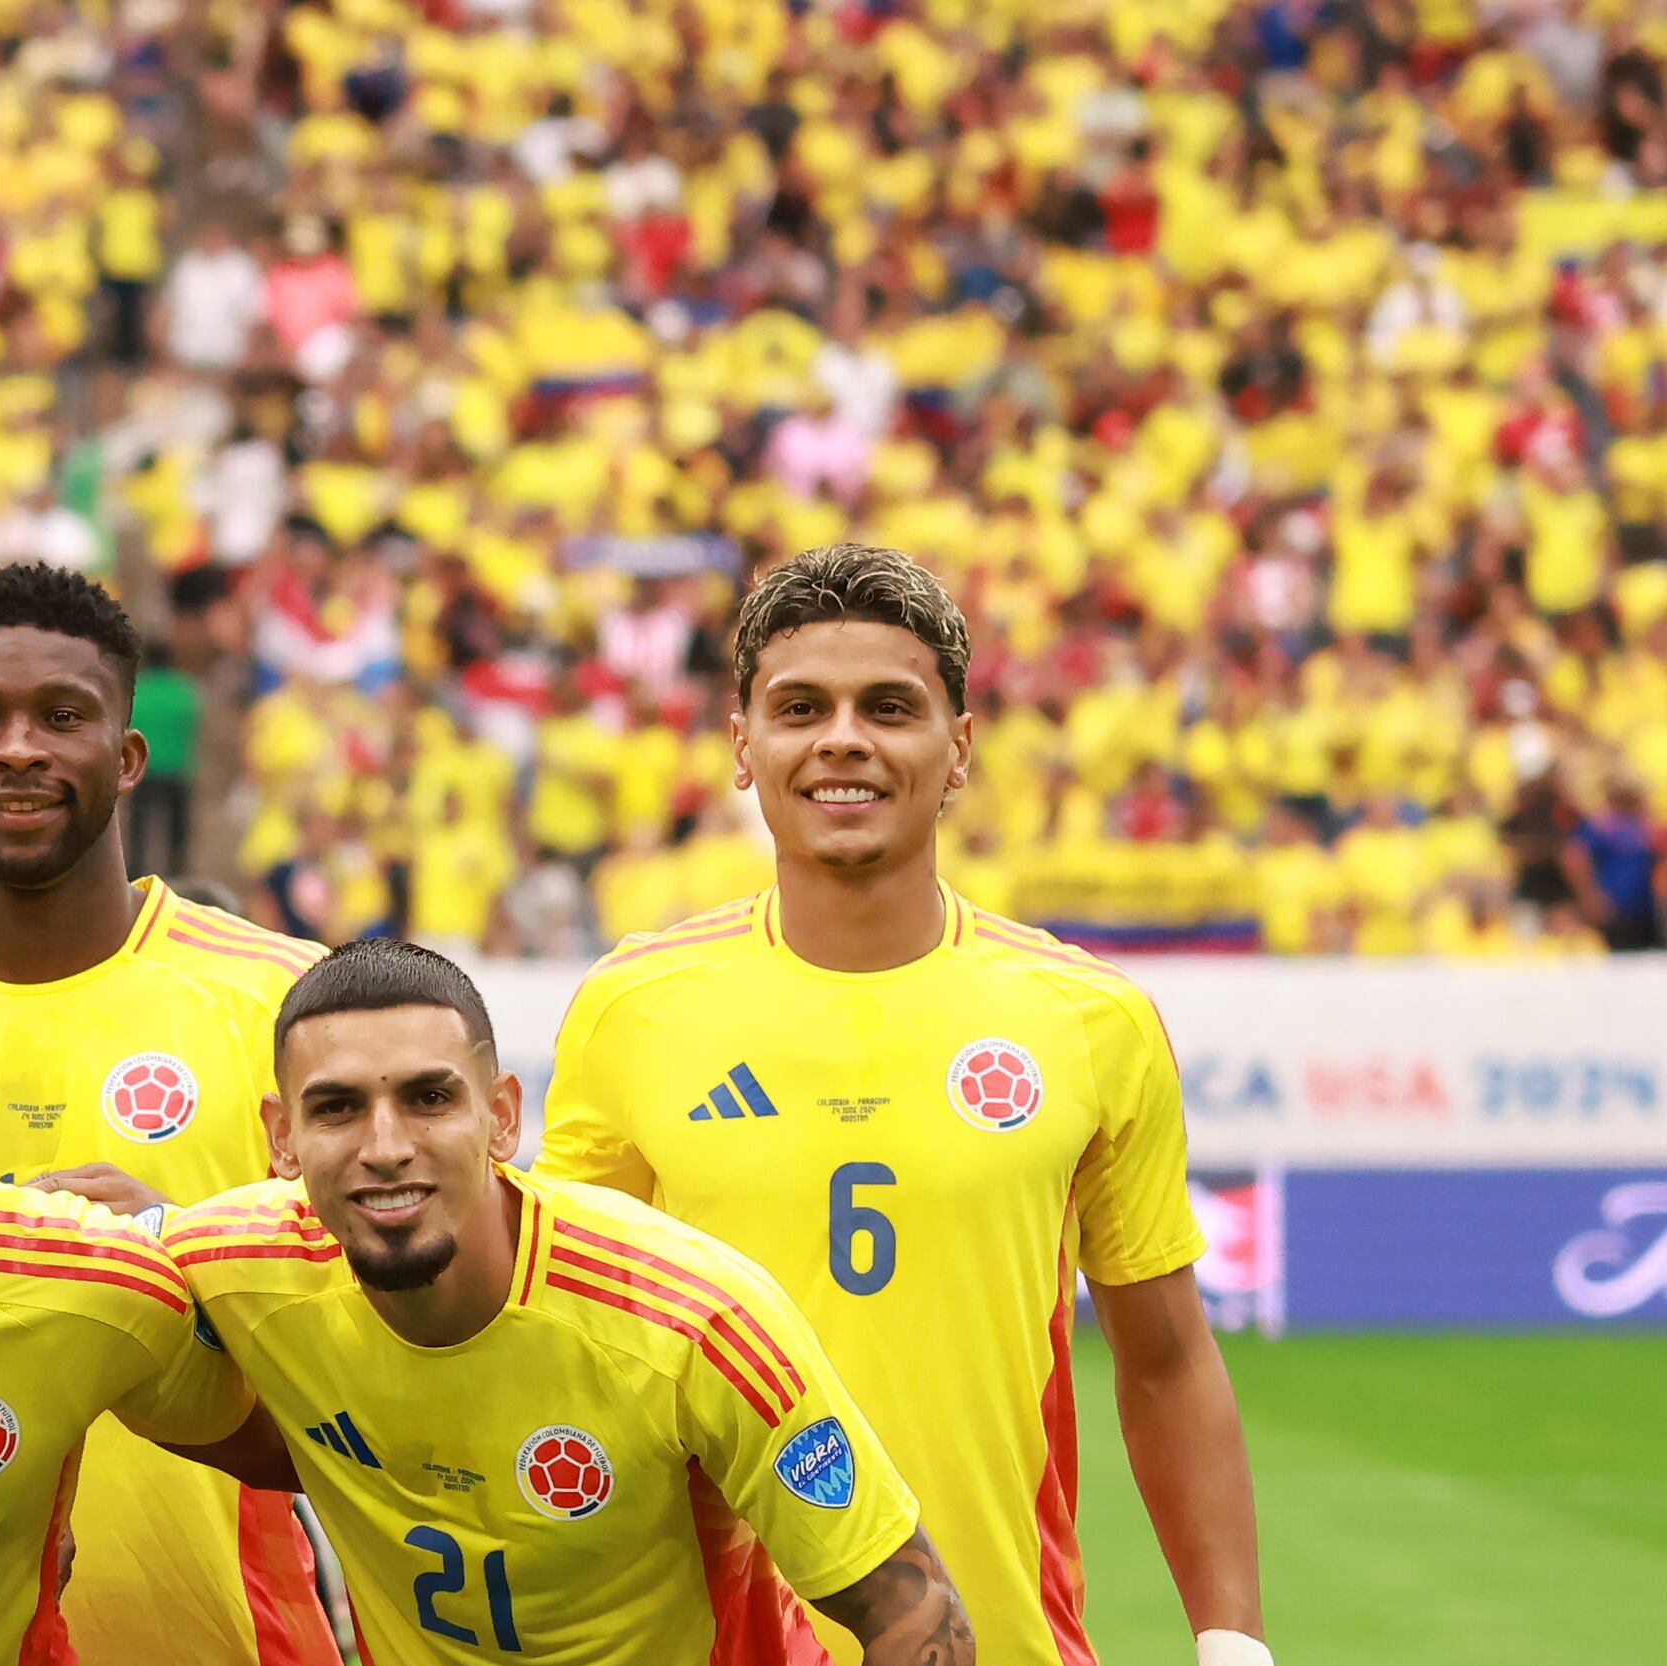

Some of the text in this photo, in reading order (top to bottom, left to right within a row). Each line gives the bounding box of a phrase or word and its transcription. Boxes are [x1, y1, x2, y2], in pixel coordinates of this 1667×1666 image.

[829, 1161, 897, 1296] 6
[0, 1408, 16, 1431] FUTBOL
[542, 1428, 586, 1440] COLOMBIANA
[594, 1448, 609, 1474] FUTBOL
[791, 1435, 839, 1482] VIBRA
[404, 1525, 522, 1652] 21
